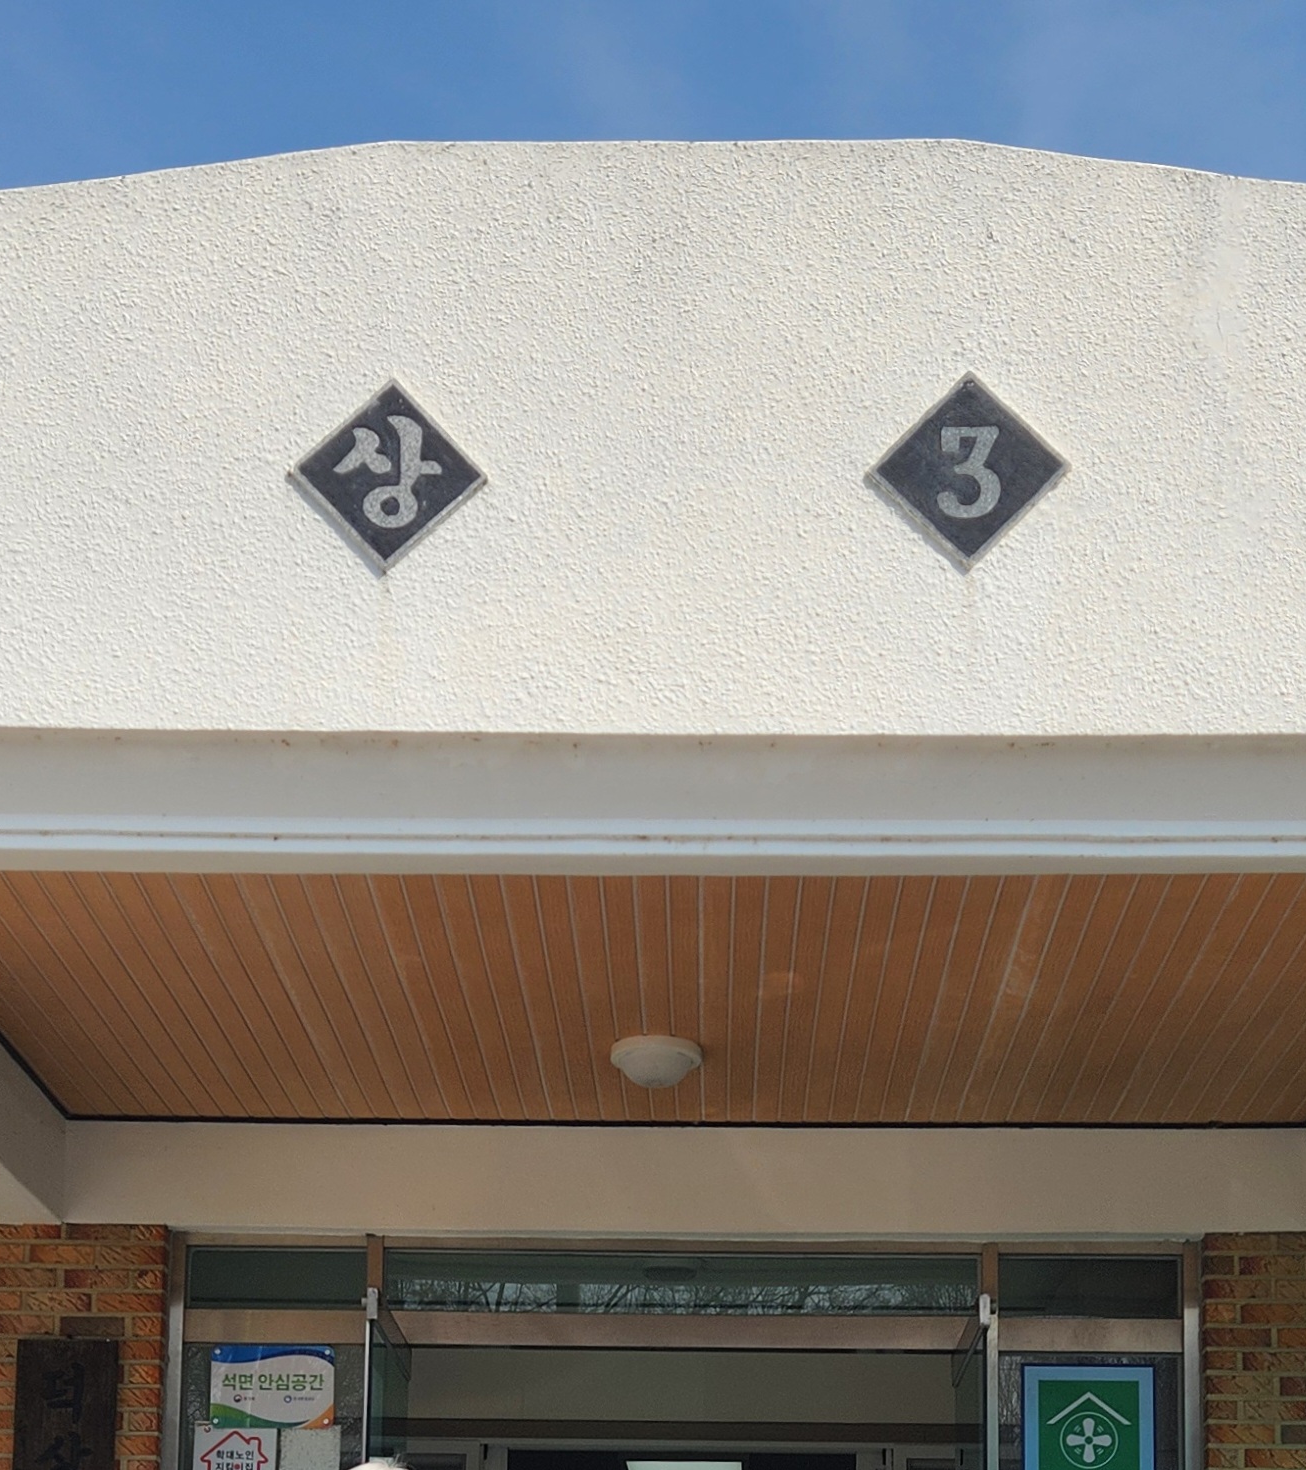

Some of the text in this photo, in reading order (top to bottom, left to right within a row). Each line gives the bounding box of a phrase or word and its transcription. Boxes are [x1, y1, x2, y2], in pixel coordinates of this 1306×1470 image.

[336, 413, 442, 529] 상
[938, 424, 1002, 520] 3
[221, 1373, 325, 1391] 석면 안심공간
[215, 1449, 255, 1461] 학대노인
